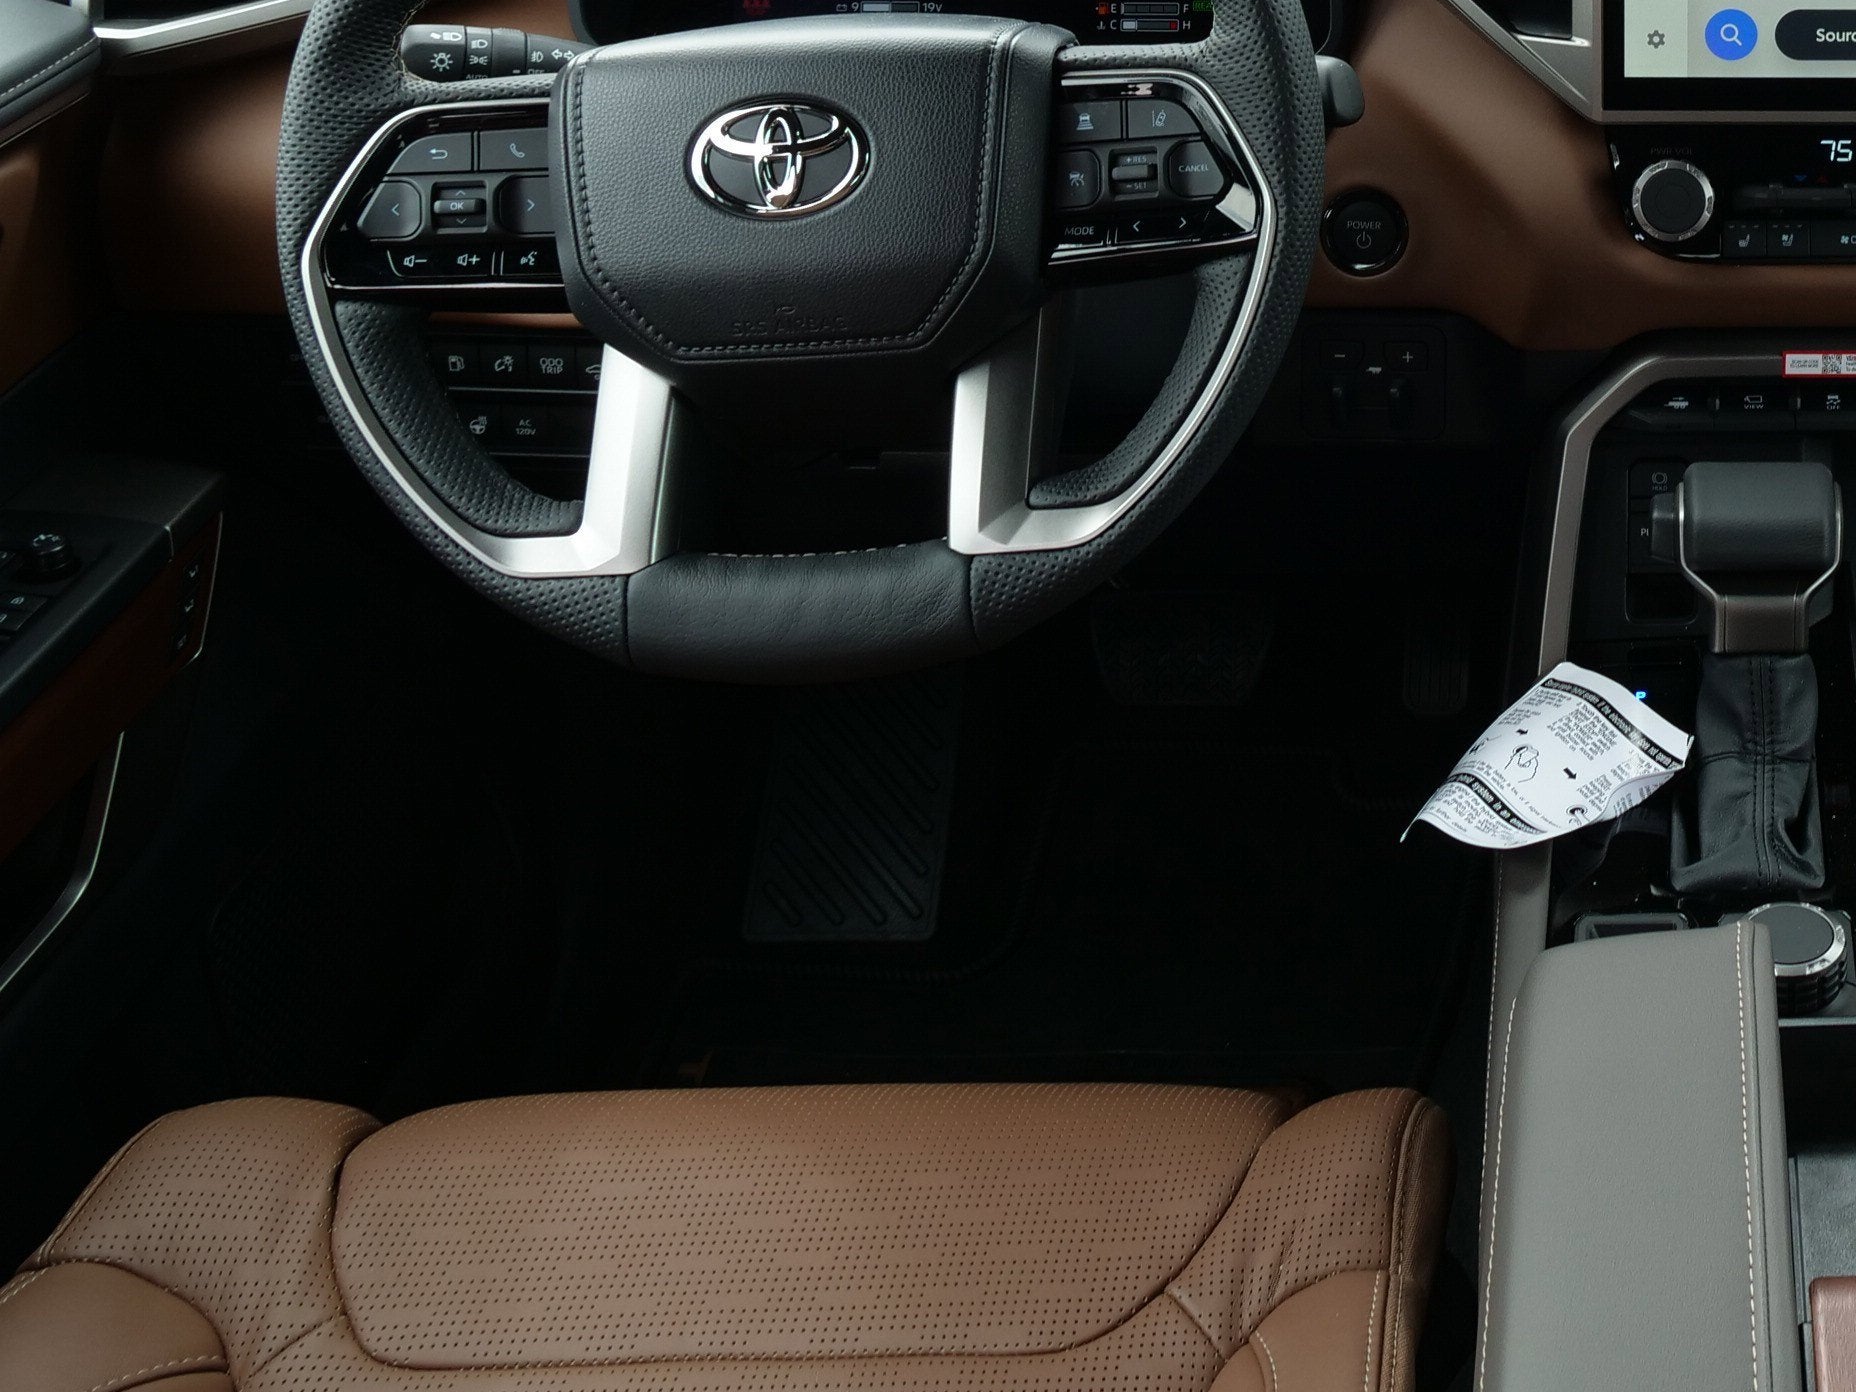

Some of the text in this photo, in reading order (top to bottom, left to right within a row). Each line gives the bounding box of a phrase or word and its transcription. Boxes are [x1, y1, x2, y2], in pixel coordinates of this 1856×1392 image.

[851, 2, 859, 12] 9
[922, 2, 943, 12] 19V
[1110, 4, 1117, 13] E
[1183, 4, 1189, 13] F
[1192, 1, 1214, 11] REA
[1110, 20, 1117, 29] C
[1183, 21, 1191, 30] H
[1820, 139, 1852, 163] 75
[1178, 163, 1209, 173] CANCEL
[449, 201, 464, 211] OK
[1346, 220, 1381, 230] POWER
[1063, 225, 1095, 237] MODE
[539, 358, 563, 367] ODO
[541, 366, 563, 375] TRIP
[518, 418, 532, 427] AC
[515, 426, 536, 435] 120V
[1472, 782, 1510, 818] system in an
